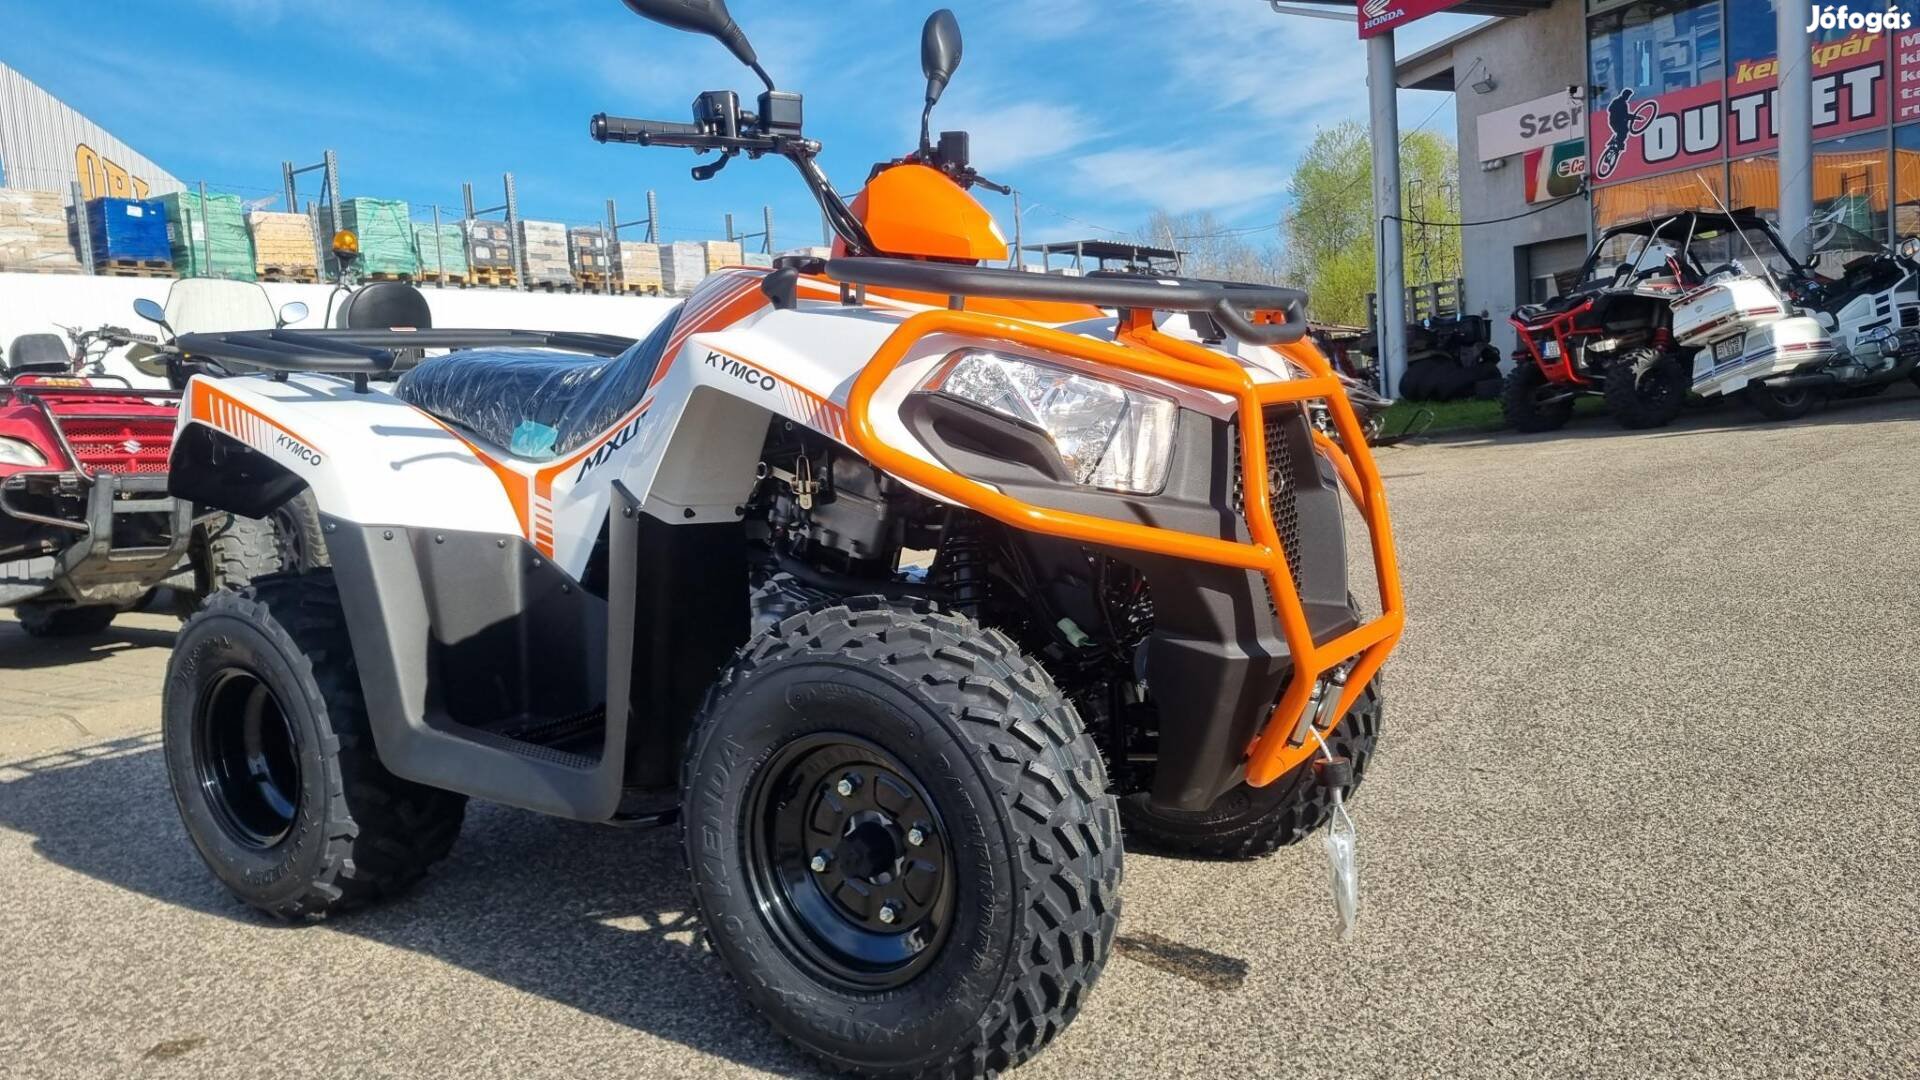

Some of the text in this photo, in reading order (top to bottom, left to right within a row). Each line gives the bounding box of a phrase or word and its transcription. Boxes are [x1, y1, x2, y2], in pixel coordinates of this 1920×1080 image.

[1364, 9, 1405, 29] HONDA
[704, 351, 776, 391] KYMCO
[276, 433, 322, 466] KYMCO
[702, 735, 744, 897] KENDA
